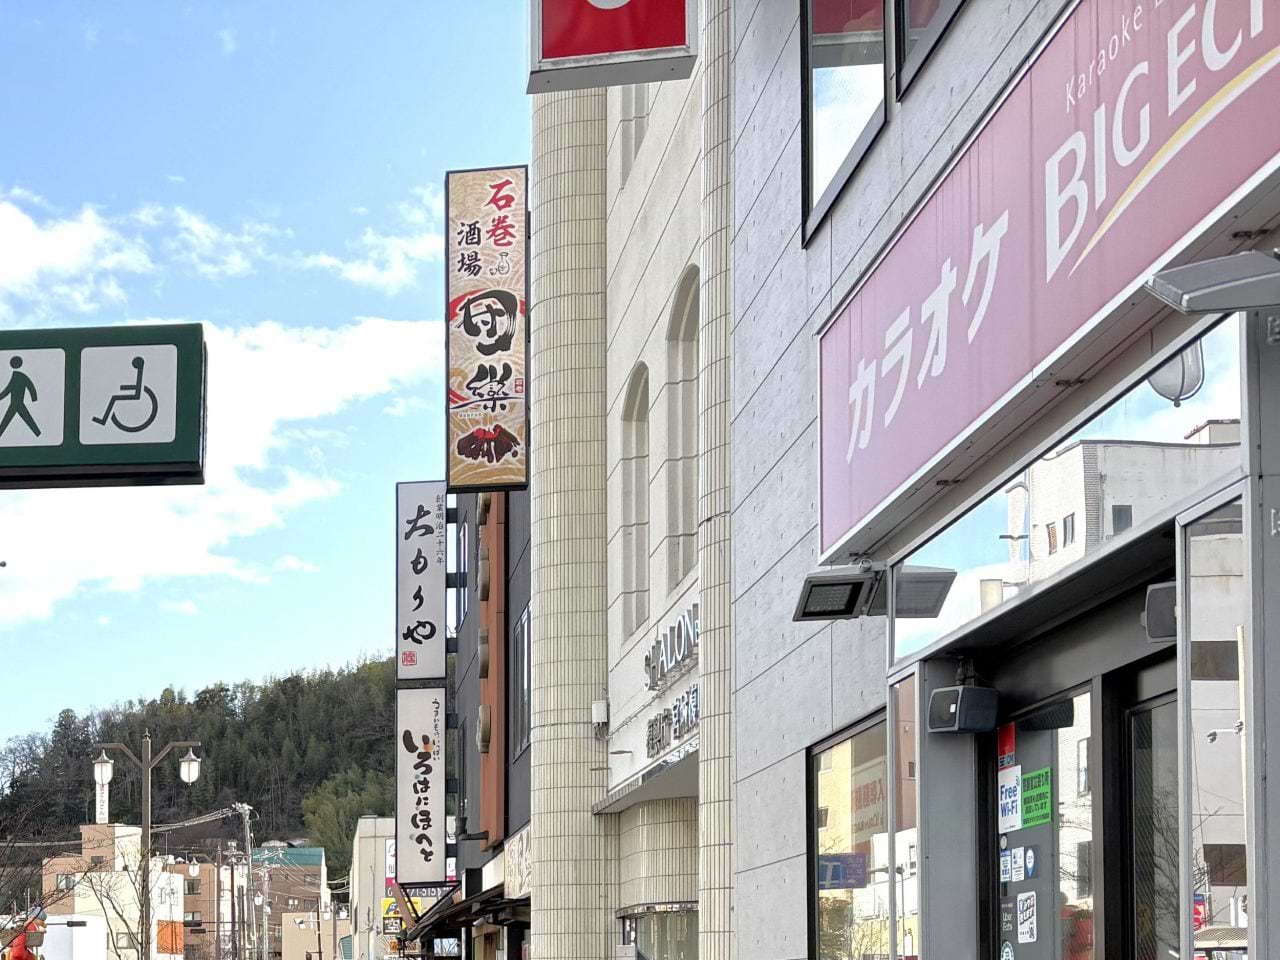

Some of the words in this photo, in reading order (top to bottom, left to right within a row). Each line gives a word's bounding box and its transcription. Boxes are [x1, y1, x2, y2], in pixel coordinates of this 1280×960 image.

[1065, 5, 1143, 113] Karaoke
[1045, 61, 1150, 283] BIG
[1167, 0, 1264, 117] EC
[457, 222, 482, 278] 酒場
[485, 179, 516, 247] 石巻
[846, 206, 1009, 464] カラオケ
[403, 730, 434, 862] いろはにほへと
[1000, 784, 1018, 801] Free
[1000, 800, 1018, 817] Wi-Fi
